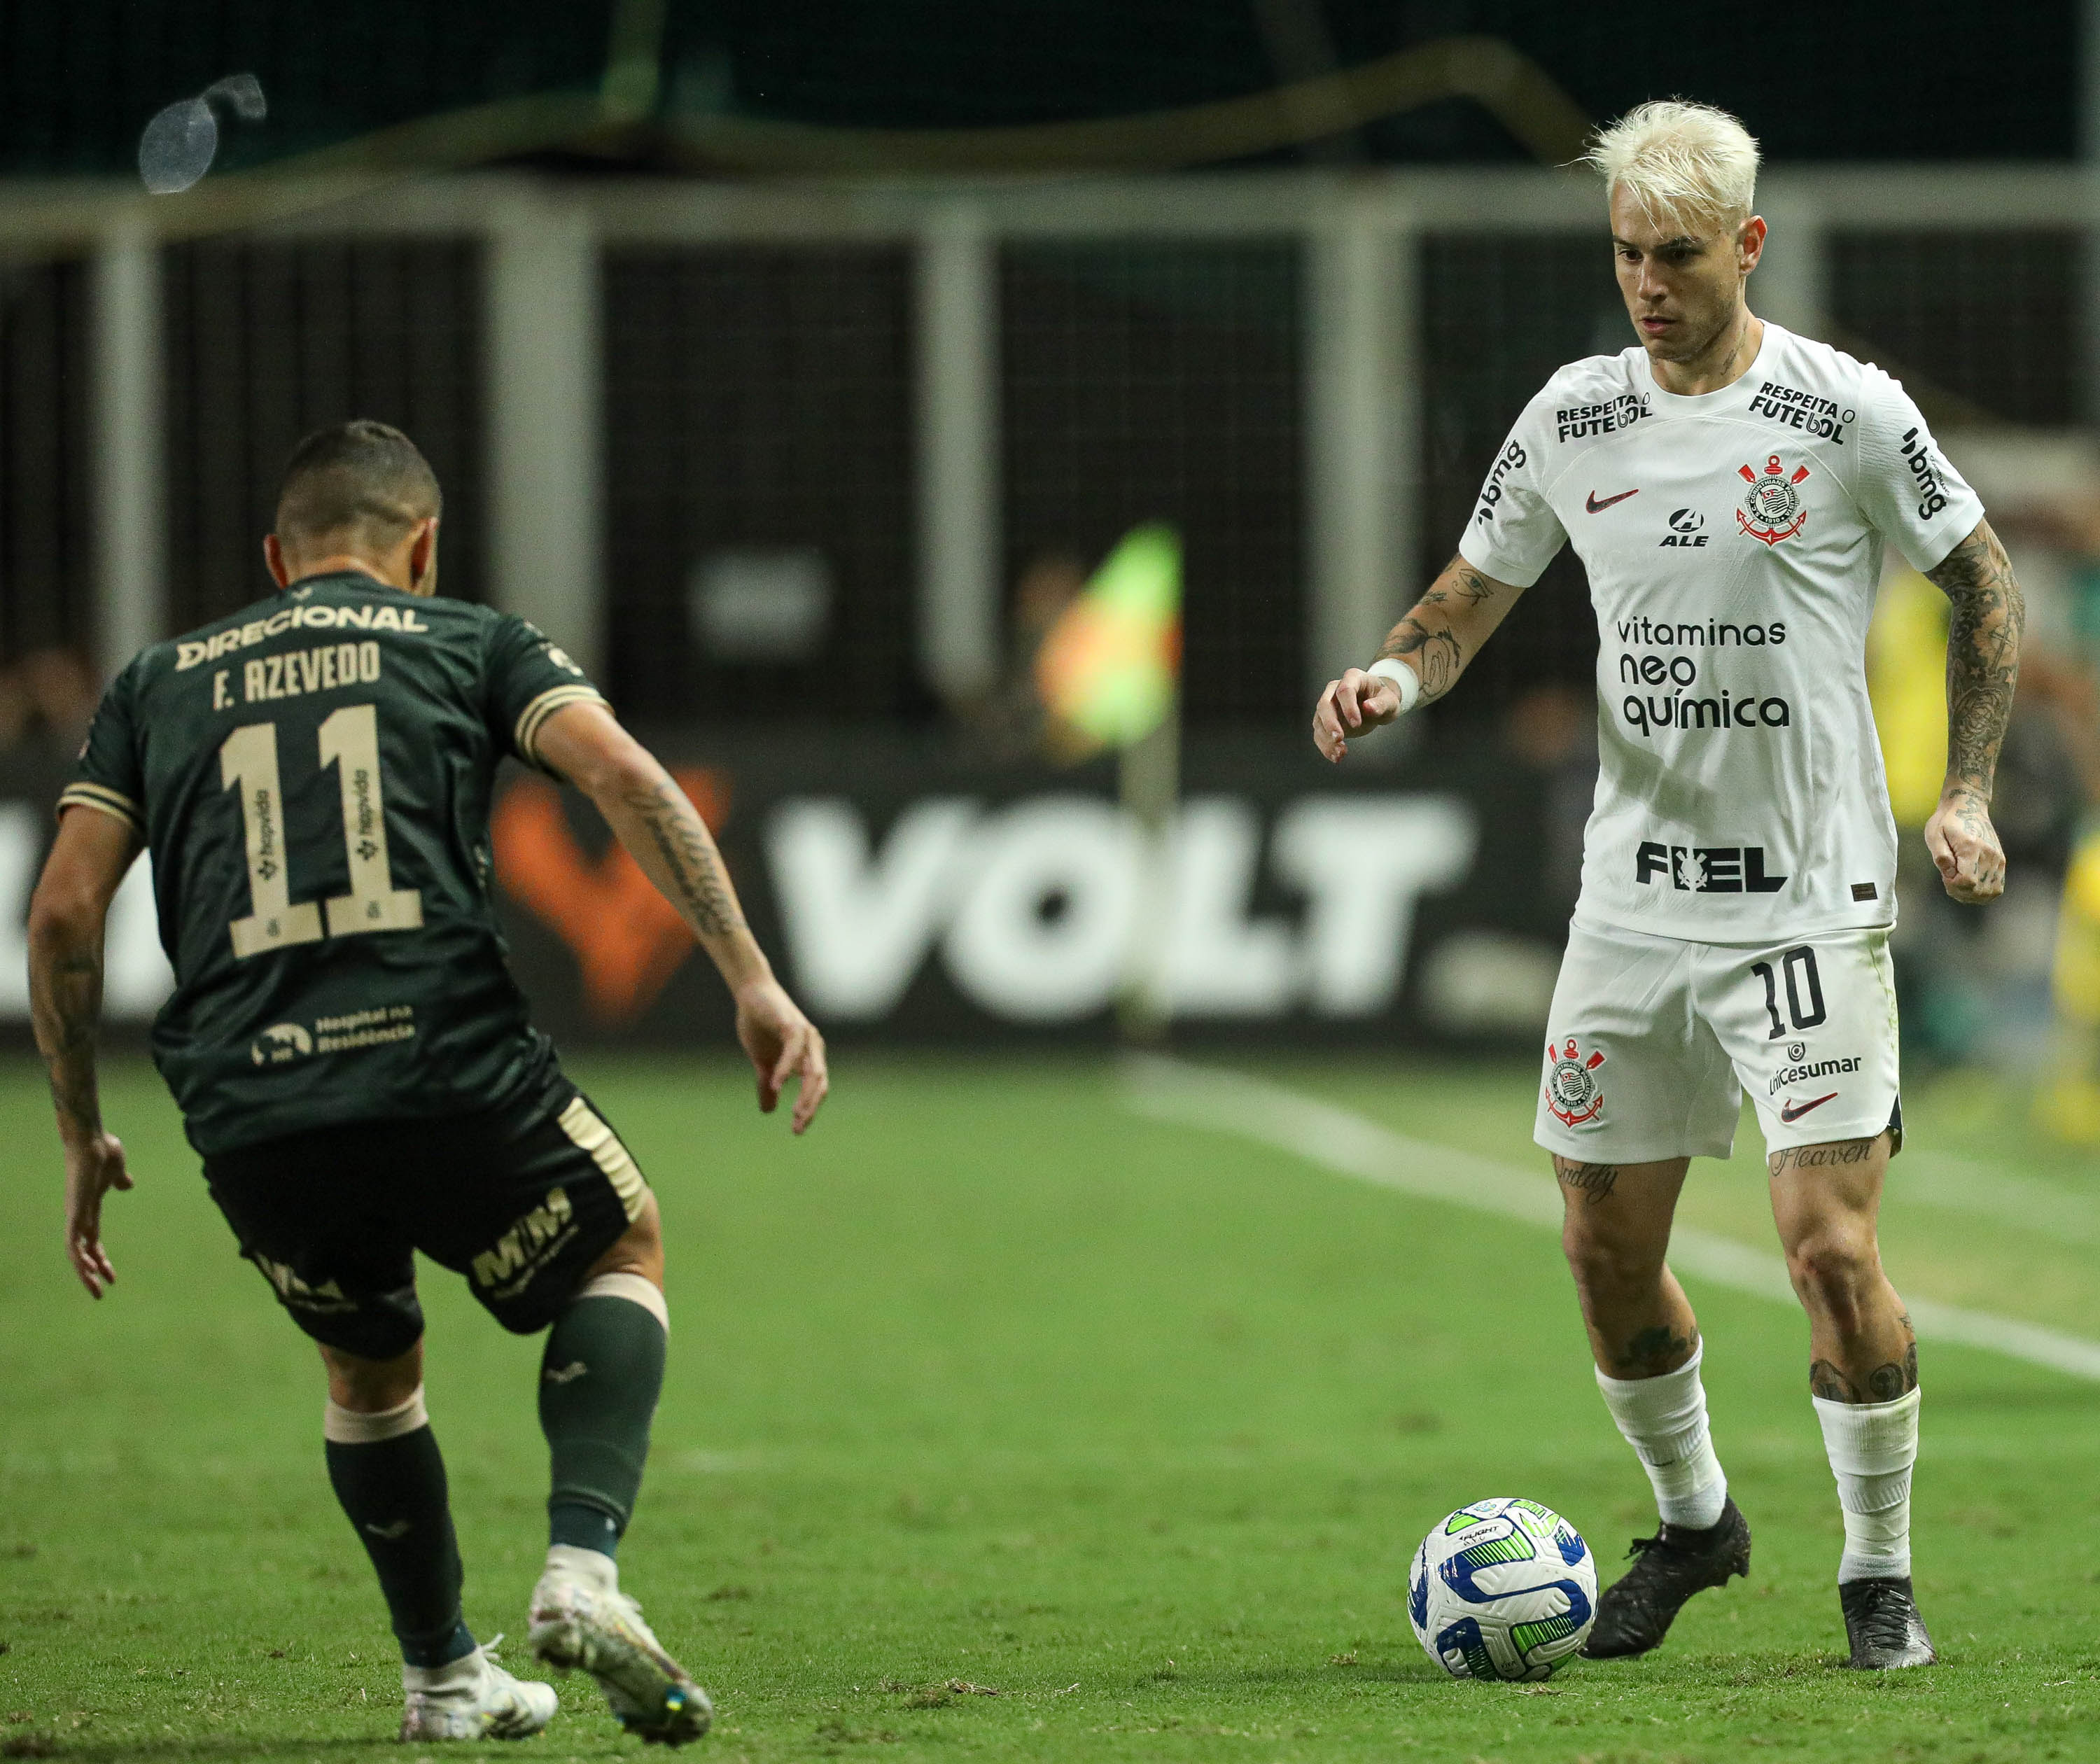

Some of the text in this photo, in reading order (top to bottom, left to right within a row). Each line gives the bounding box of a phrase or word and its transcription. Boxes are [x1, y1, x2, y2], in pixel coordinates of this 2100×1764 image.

[1557, 395, 1638, 424] RESPEITA
[1759, 382, 1856, 424] RESPEITA O
[1481, 439, 1527, 507] bmg
[1907, 446, 1947, 520] bmg
[1751, 479, 1786, 504] CORINTHIANS
[1784, 486, 1795, 516] PAULISTA
[1658, 536, 1709, 547] ALE
[175, 605, 428, 672] DIRECIONAL
[1618, 616, 1786, 646] vitaminas
[213, 641, 382, 712] F. AZEVEDO
[1620, 653, 1696, 687] neo
[1623, 688, 1789, 736] química
[219, 704, 424, 960] 11
[766, 795, 1477, 1023] VOLT
[1751, 945, 1827, 1040] 10
[1463, 1525, 1499, 1541] FLIGHT
